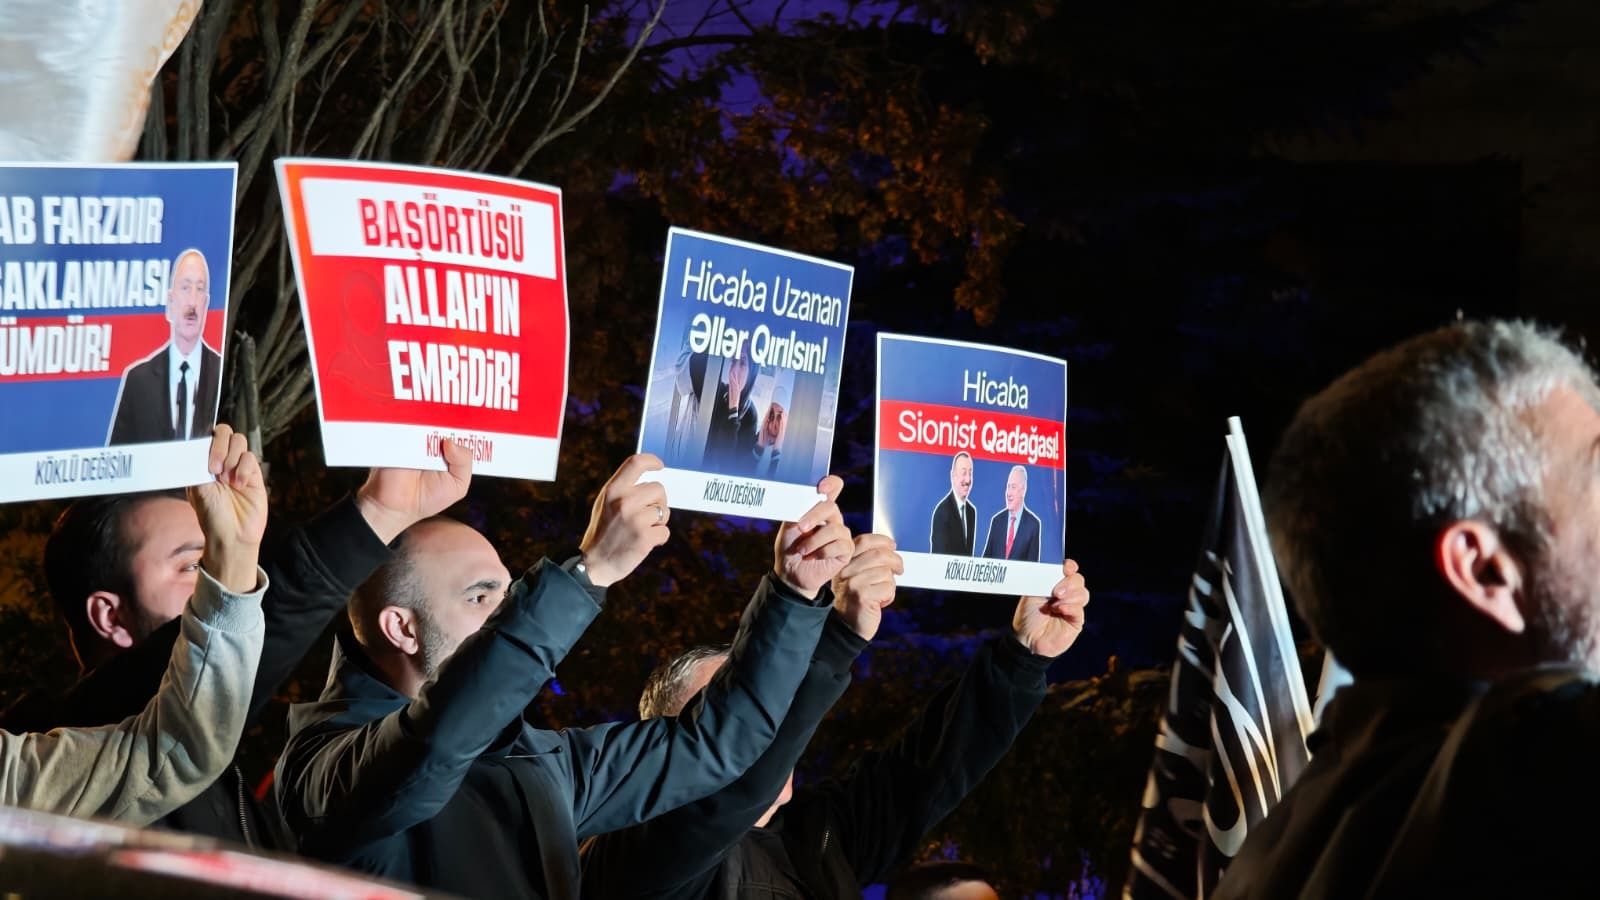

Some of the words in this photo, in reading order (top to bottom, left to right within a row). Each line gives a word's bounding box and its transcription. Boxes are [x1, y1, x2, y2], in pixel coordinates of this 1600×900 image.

[42, 196, 164, 245] FARZDIR
[357, 192, 524, 263] BAŞÖRTÜSÜ
[0, 258, 171, 310] AKLANMASI
[383, 264, 521, 338] ALLAH'IN
[681, 257, 768, 313] Hicaba
[771, 275, 842, 328] Uzanan
[689, 312, 750, 361] Əllər
[962, 369, 1029, 410] Hicaba
[898, 409, 978, 450] Sionist
[980, 420, 1060, 465] Qadağası!
[35, 454, 79, 486] KÖKLÜ
[702, 478, 734, 503] KÖKLÜ
[730, 481, 767, 509] DEĞİŞİM
[944, 558, 975, 581] KÖKLÜ
[971, 561, 1008, 586] DEĞİŞİM
